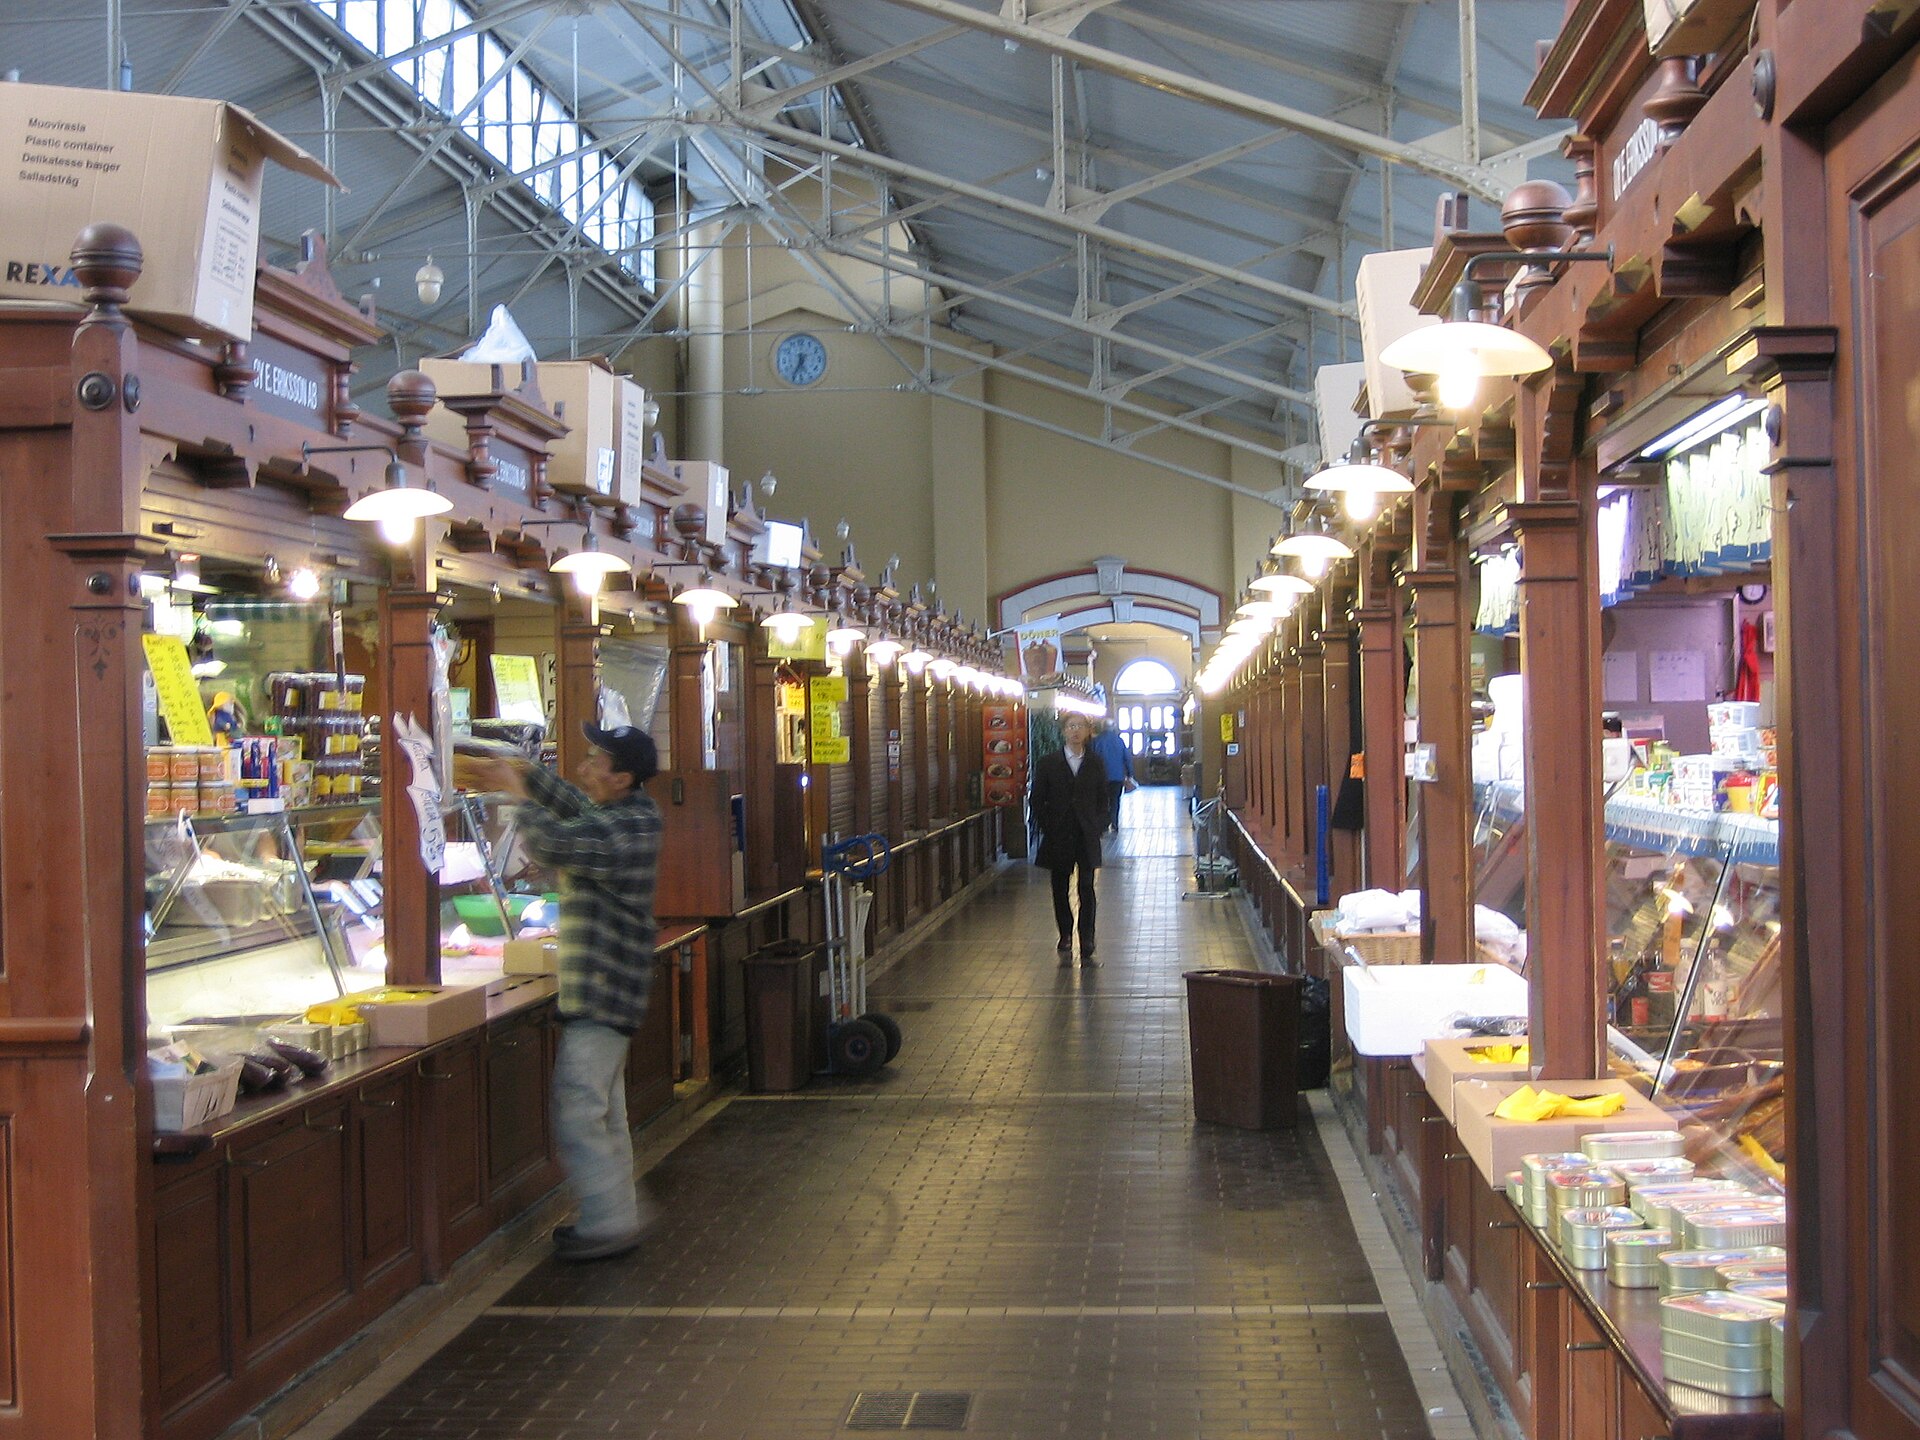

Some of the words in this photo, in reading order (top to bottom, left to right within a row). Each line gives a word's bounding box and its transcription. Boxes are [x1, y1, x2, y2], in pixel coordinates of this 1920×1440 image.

[25, 134, 61, 149] Plastic
[63, 140, 115, 154] container
[22, 152, 83, 169] Delikatesse
[1021, 629, 1058, 640] DÖNER
